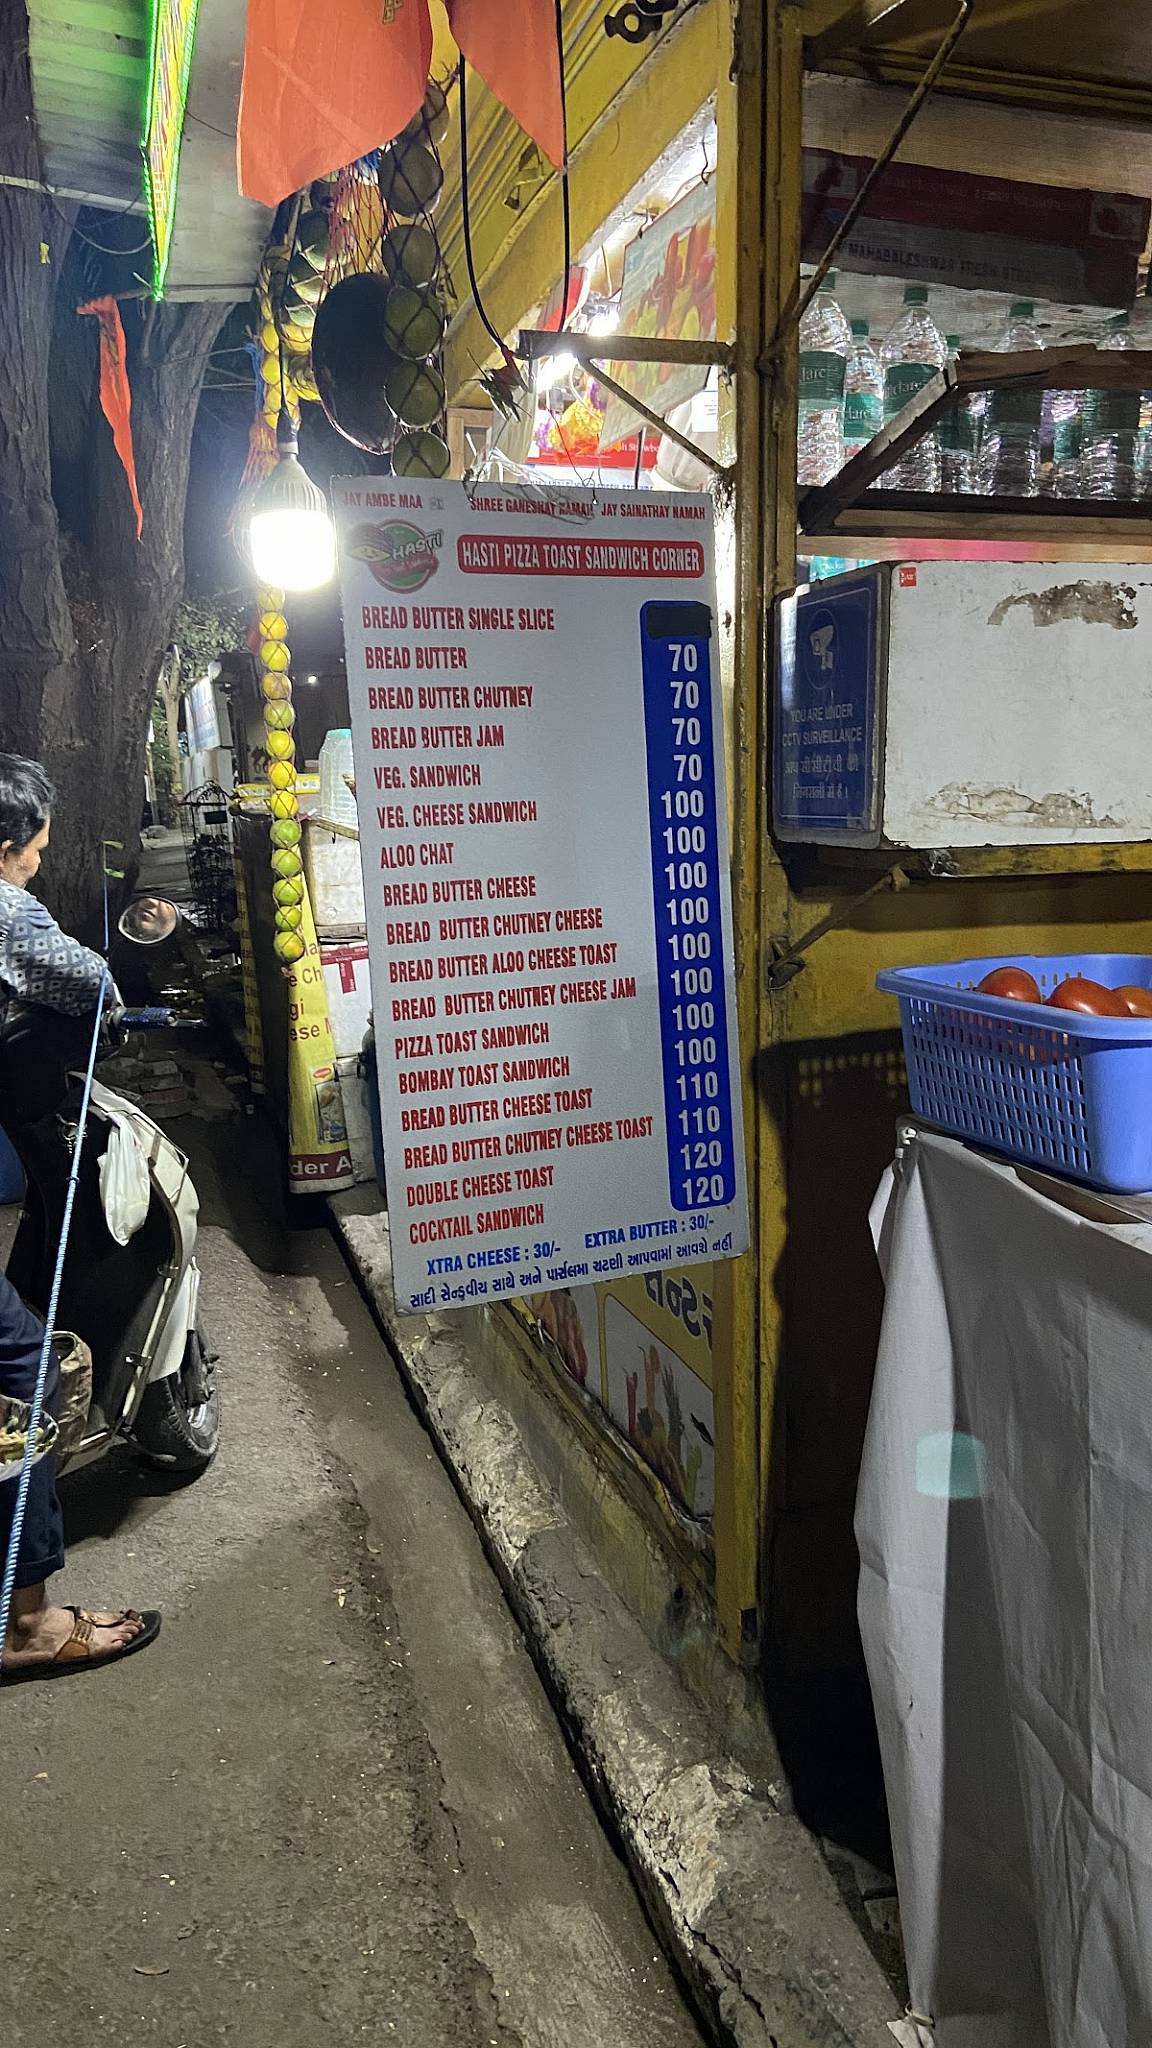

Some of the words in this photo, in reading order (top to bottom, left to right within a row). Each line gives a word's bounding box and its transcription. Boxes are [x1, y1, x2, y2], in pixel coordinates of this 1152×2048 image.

[344, 491, 362, 506] JAY
[366, 493, 396, 507] AMBE
[400, 494, 423, 508] MAA
[470, 499, 503, 511] SHREE
[506, 500, 556, 515] GANESHAY
[601, 504, 616, 516] JAY
[621, 505, 670, 519] SAINATHAY
[672, 506, 705, 519] NAMAH
[392, 530, 443, 560] HASTI
[463, 542, 499, 566] HASTI
[504, 543, 539, 568] PIZZA
[543, 545, 580, 569] TOAST
[586, 547, 647, 570] SANDWICH
[652, 548, 699, 571] CORNER
[364, 608, 406, 628] BREAD
[413, 607, 463, 629] BUTTER
[469, 608, 512, 629] SINGLE
[519, 608, 554, 629] SLICE
[366, 647, 409, 669] BREAD
[416, 647, 466, 669] BUTTER
[668, 644, 697, 672] 70
[369, 688, 413, 709] BREAD
[419, 687, 468, 709] BUTTER
[474, 687, 532, 708] CHUTNEY
[670, 681, 699, 709] 70
[808, 706, 824, 720] ARE
[372, 727, 416, 749] BREAD
[421, 726, 471, 748] BUTTER
[477, 726, 504, 746] JAM
[672, 718, 701, 745] 70
[803, 727, 862, 745] SURVEILLANCE
[376, 768, 404, 788] VEG.
[409, 765, 480, 787] SANDWICH
[674, 754, 702, 782] 70
[379, 806, 409, 828] VEG.
[413, 804, 464, 826] CHEESE
[469, 801, 536, 823] SANDWICH
[661, 790, 704, 819] 100
[663, 826, 705, 853] 100
[381, 845, 414, 868] ALOO
[420, 843, 453, 865] CHAT
[665, 862, 707, 890] 100
[384, 883, 428, 906] BREAD
[433, 880, 482, 902] BUTTER
[487, 876, 535, 898] CHEESE
[667, 897, 709, 925] 100
[387, 921, 430, 944] BREAD
[439, 917, 488, 940] BUTTER
[493, 912, 550, 936] CHUTNEY
[555, 908, 601, 930] CHEESE
[668, 932, 711, 960] 100
[389, 959, 433, 983] BREAD
[438, 954, 487, 978] BUTTER
[493, 952, 524, 973] ALOO
[528, 947, 576, 969] CHEESE
[579, 943, 616, 964] TOAST
[671, 968, 712, 995] 100
[392, 996, 435, 1021] BREAD
[444, 991, 494, 1015] BUTTER
[499, 985, 555, 1010] CHUTNEY
[560, 980, 606, 1003] CHEESE
[611, 979, 636, 999] JAM
[672, 1002, 714, 1030] 100
[395, 1036, 433, 1057] PIZZA
[436, 1030, 477, 1054] TOAST
[482, 1024, 549, 1049] SANDWICH
[674, 1037, 716, 1065] 100
[399, 1068, 453, 1094] BOMBAY
[459, 1063, 497, 1087] TOAST
[501, 1057, 569, 1082] SANDWICH
[676, 1071, 718, 1100] 110
[401, 1106, 445, 1131] BREAD
[449, 1100, 499, 1126] BUTTER
[504, 1093, 551, 1118] CHEESE
[555, 1088, 592, 1111] TOAST
[678, 1106, 720, 1135] 110
[405, 1144, 448, 1168] BREAD
[451, 1136, 501, 1162] BUTTER
[505, 1128, 561, 1155] CHUTNEY
[566, 1121, 613, 1147] CHEESE
[617, 1117, 652, 1138] TOAST
[680, 1140, 722, 1170] 120
[407, 1178, 458, 1207] DOUBLE
[462, 1171, 512, 1198] CHEESE
[515, 1165, 553, 1189] TOAST
[682, 1174, 724, 1205] 120
[410, 1216, 472, 1244] COCKTAIL
[477, 1205, 544, 1232] SANDWICH
[585, 1230, 625, 1248] EXTRA
[630, 1220, 676, 1240] BUTTER
[428, 1257, 462, 1274] XTRA
[467, 1247, 519, 1268] CHEESE
